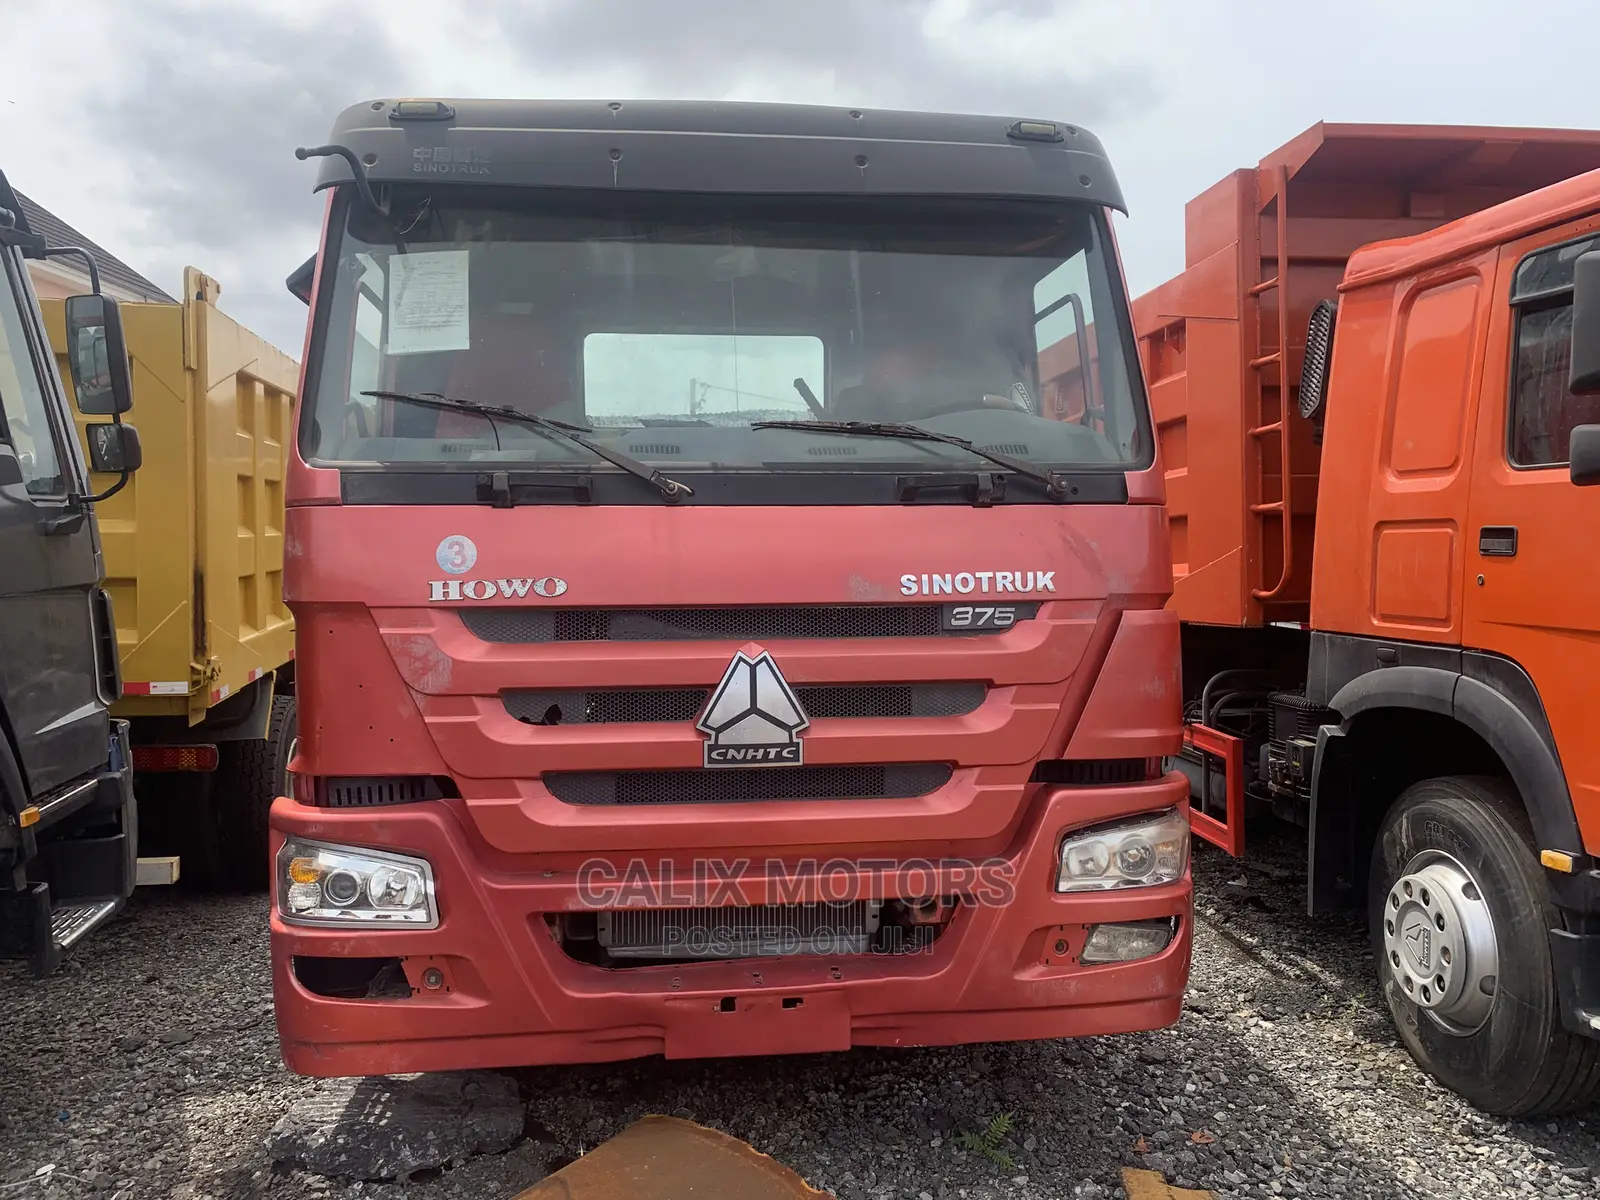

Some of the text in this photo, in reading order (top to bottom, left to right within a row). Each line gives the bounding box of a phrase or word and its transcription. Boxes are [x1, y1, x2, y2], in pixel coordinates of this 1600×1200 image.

[448, 540, 468, 568] 3
[428, 576, 568, 601] HOWO
[900, 571, 1057, 596] SINOTRUK
[951, 606, 1016, 627] 375
[710, 747, 797, 760] CNHTC
